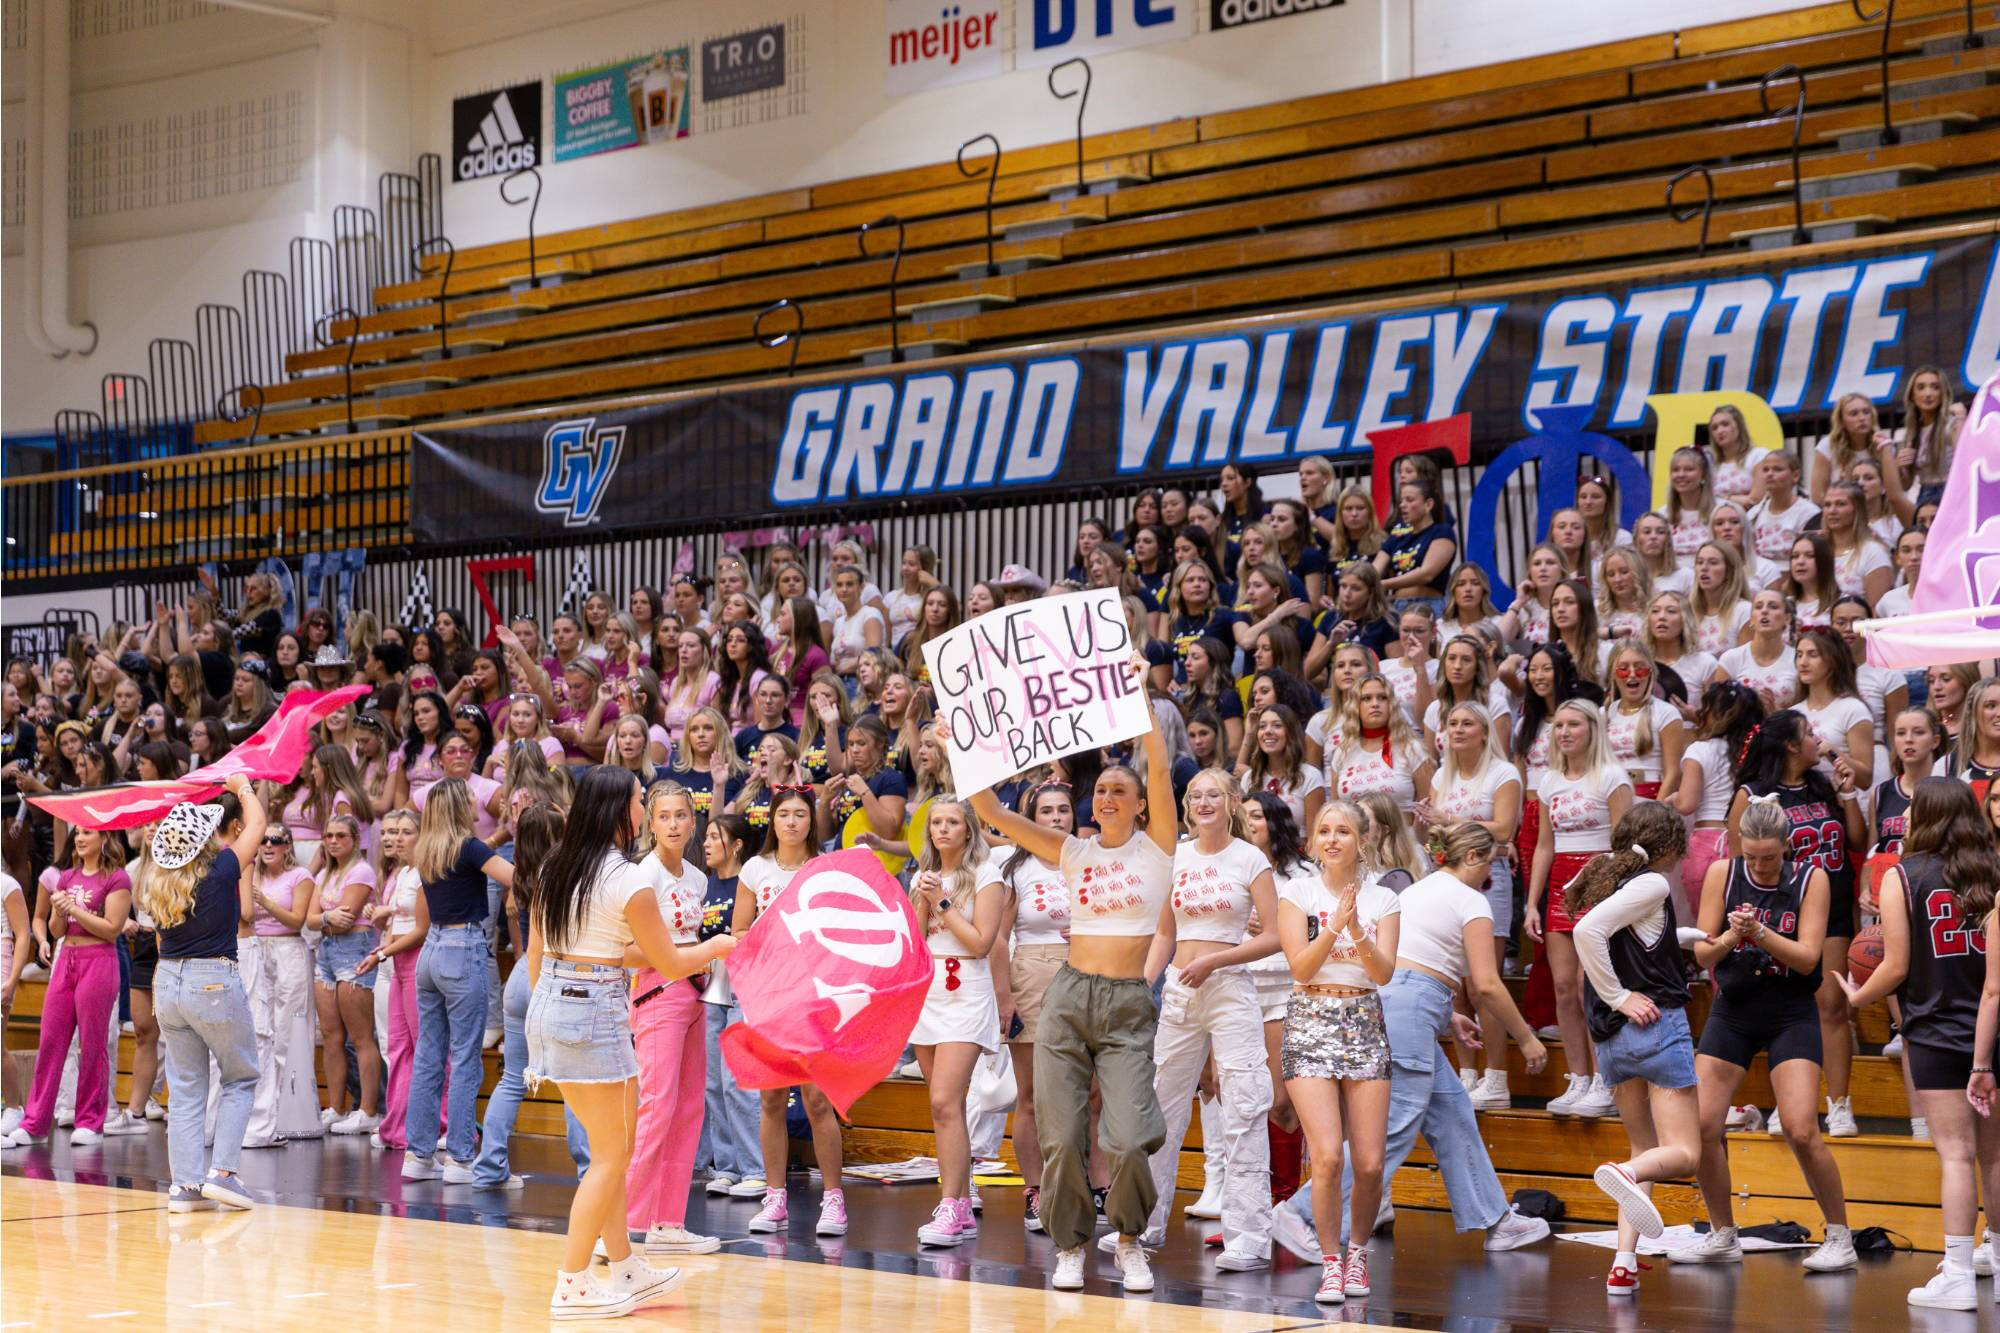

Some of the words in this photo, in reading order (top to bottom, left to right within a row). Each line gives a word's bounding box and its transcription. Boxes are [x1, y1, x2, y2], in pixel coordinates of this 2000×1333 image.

[890, 6, 997, 66] meijer
[566, 77, 612, 106] BIGGBY
[569, 98, 611, 126] COFFEE
[459, 143, 536, 180] adidas
[772, 355, 1082, 506] GRAND
[1117, 303, 1508, 474] VALLEY
[1523, 252, 1935, 432] STATE
[535, 418, 627, 527] GV
[937, 609, 1046, 696] GIVE
[1062, 599, 1127, 659] US
[951, 687, 1014, 752] OUR
[1024, 661, 1139, 718] BESTIE
[1008, 711, 1094, 769] BACK
[1790, 819, 1845, 872] 23
[1882, 815, 1909, 836] PH
